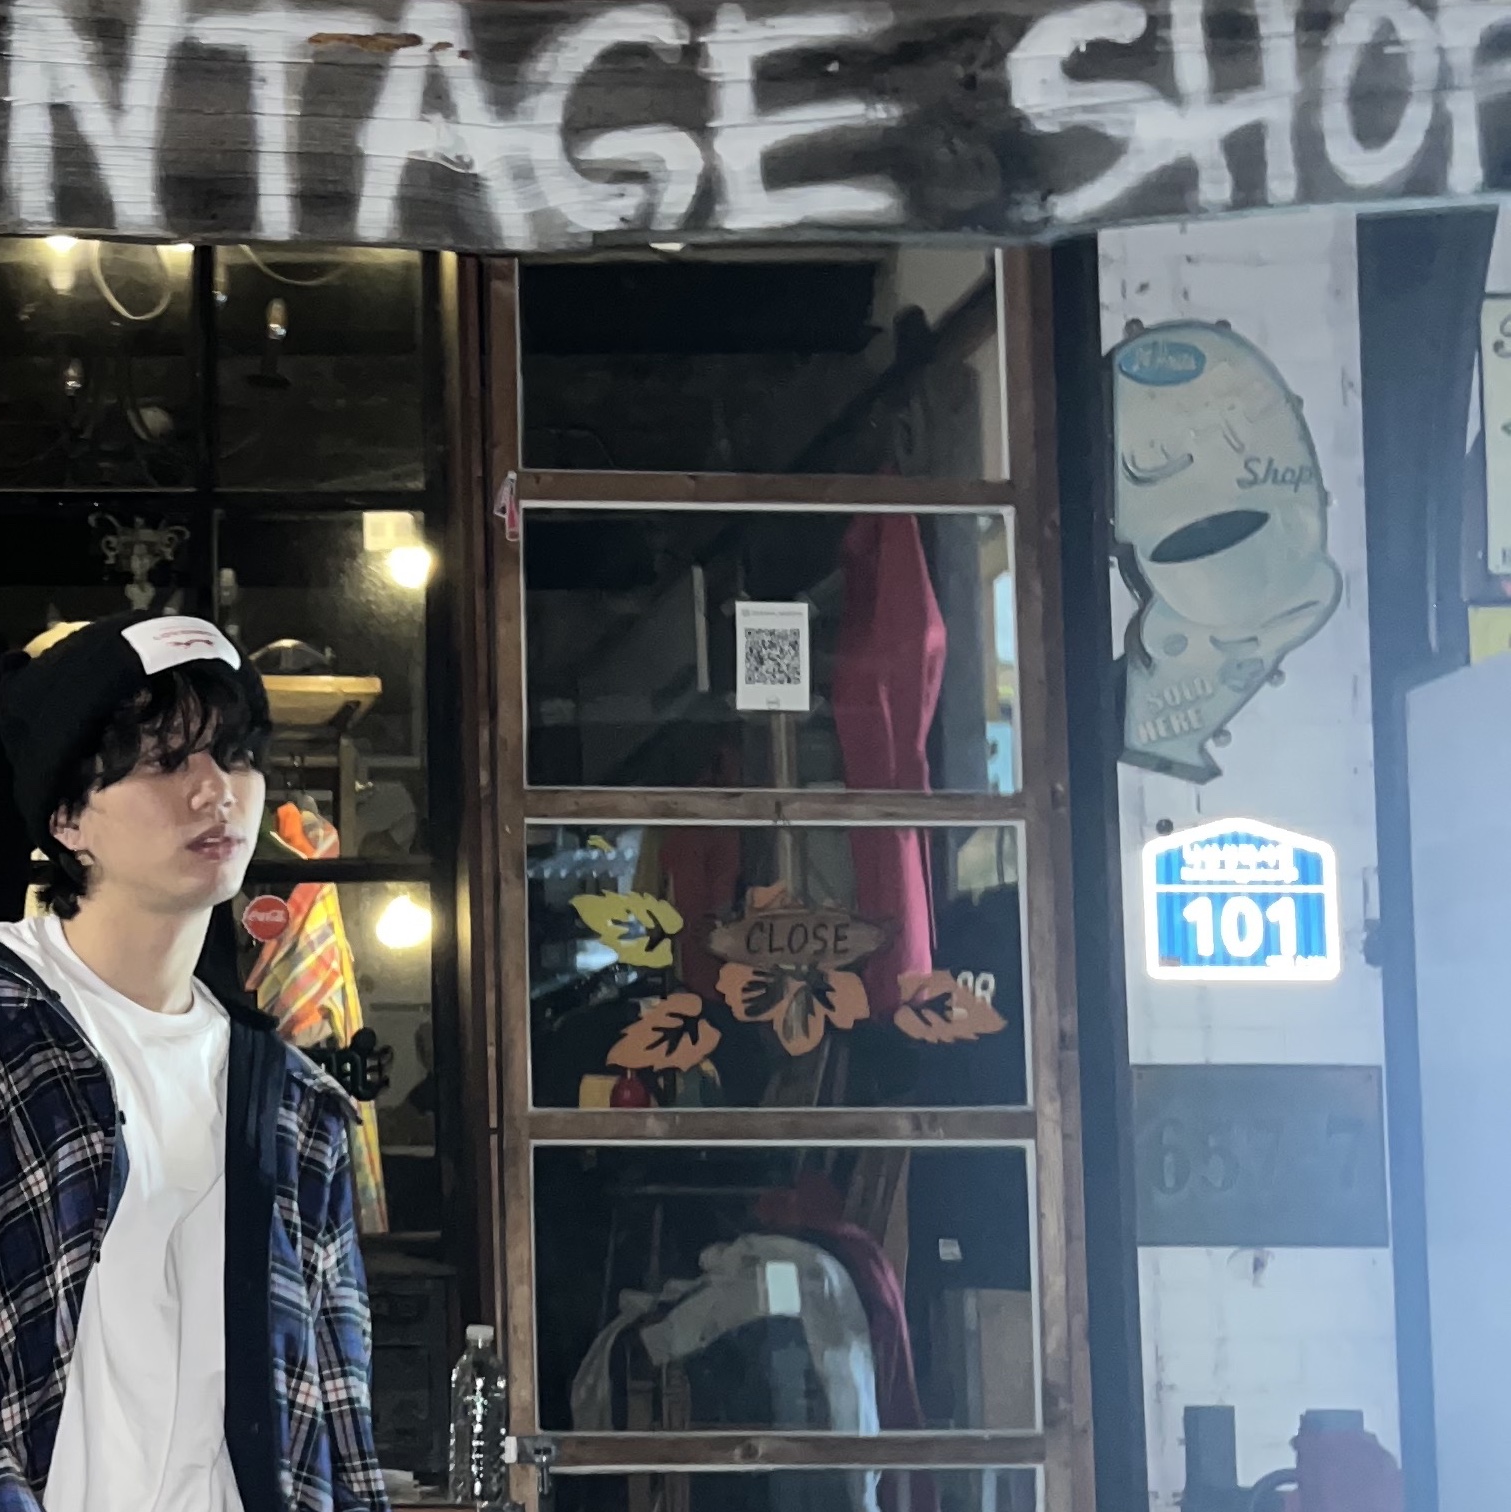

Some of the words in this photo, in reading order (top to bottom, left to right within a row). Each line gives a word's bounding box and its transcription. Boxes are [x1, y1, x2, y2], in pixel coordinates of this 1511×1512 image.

[1236, 456, 1316, 493] Shop
[1138, 708, 1204, 744] HERE
[746, 921, 851, 954] CLOSE
[1183, 896, 1298, 957] 101
